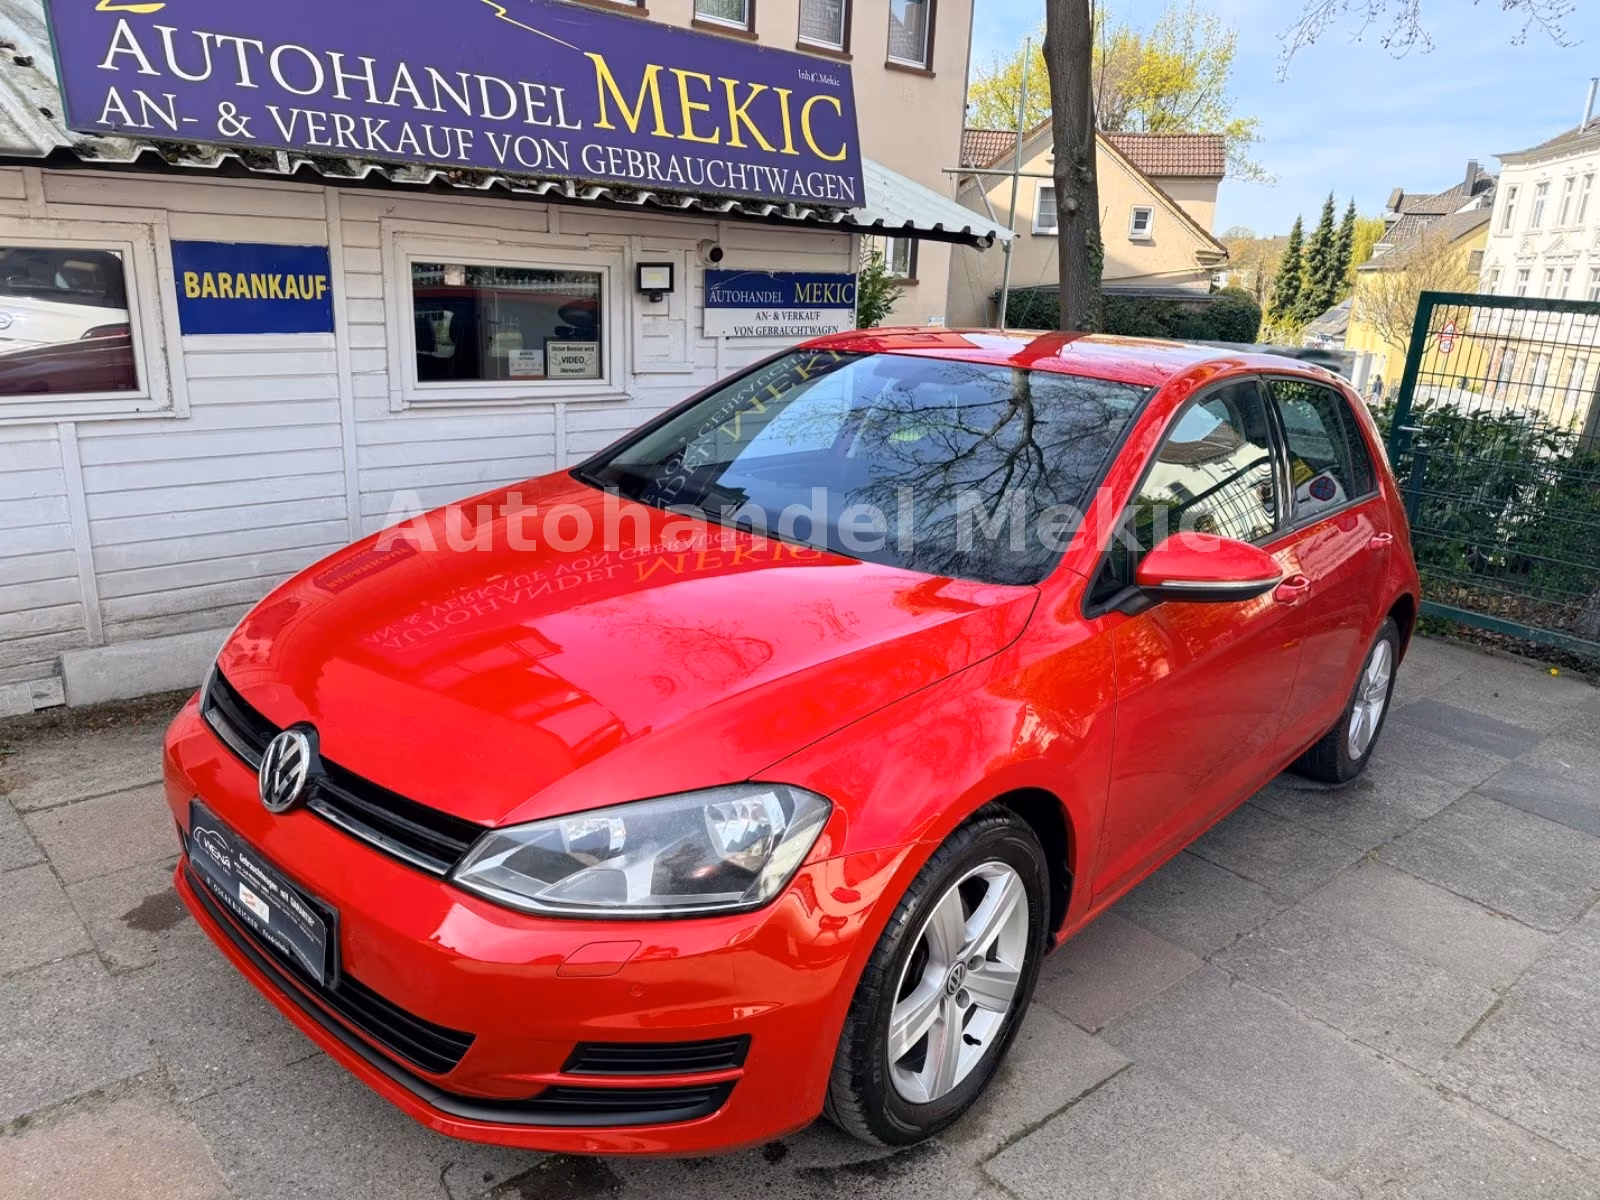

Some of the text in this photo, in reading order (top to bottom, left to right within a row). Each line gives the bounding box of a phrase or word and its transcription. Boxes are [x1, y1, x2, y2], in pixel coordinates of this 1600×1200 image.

[97, 18, 847, 162] AUTOHANDEL MEKIC
[96, 86, 855, 201] AN- & VERKAUF VON GEBRAUCHTWAGEN
[183, 271, 327, 301] BARANKAUF
[709, 282, 855, 305] AUTOHANDEL MEKIC
[755, 311, 821, 321] AN- & VERKAUF
[733, 325, 839, 336] VON GEBRAUCHTWAGEN
[561, 355, 585, 364] VIDEO
